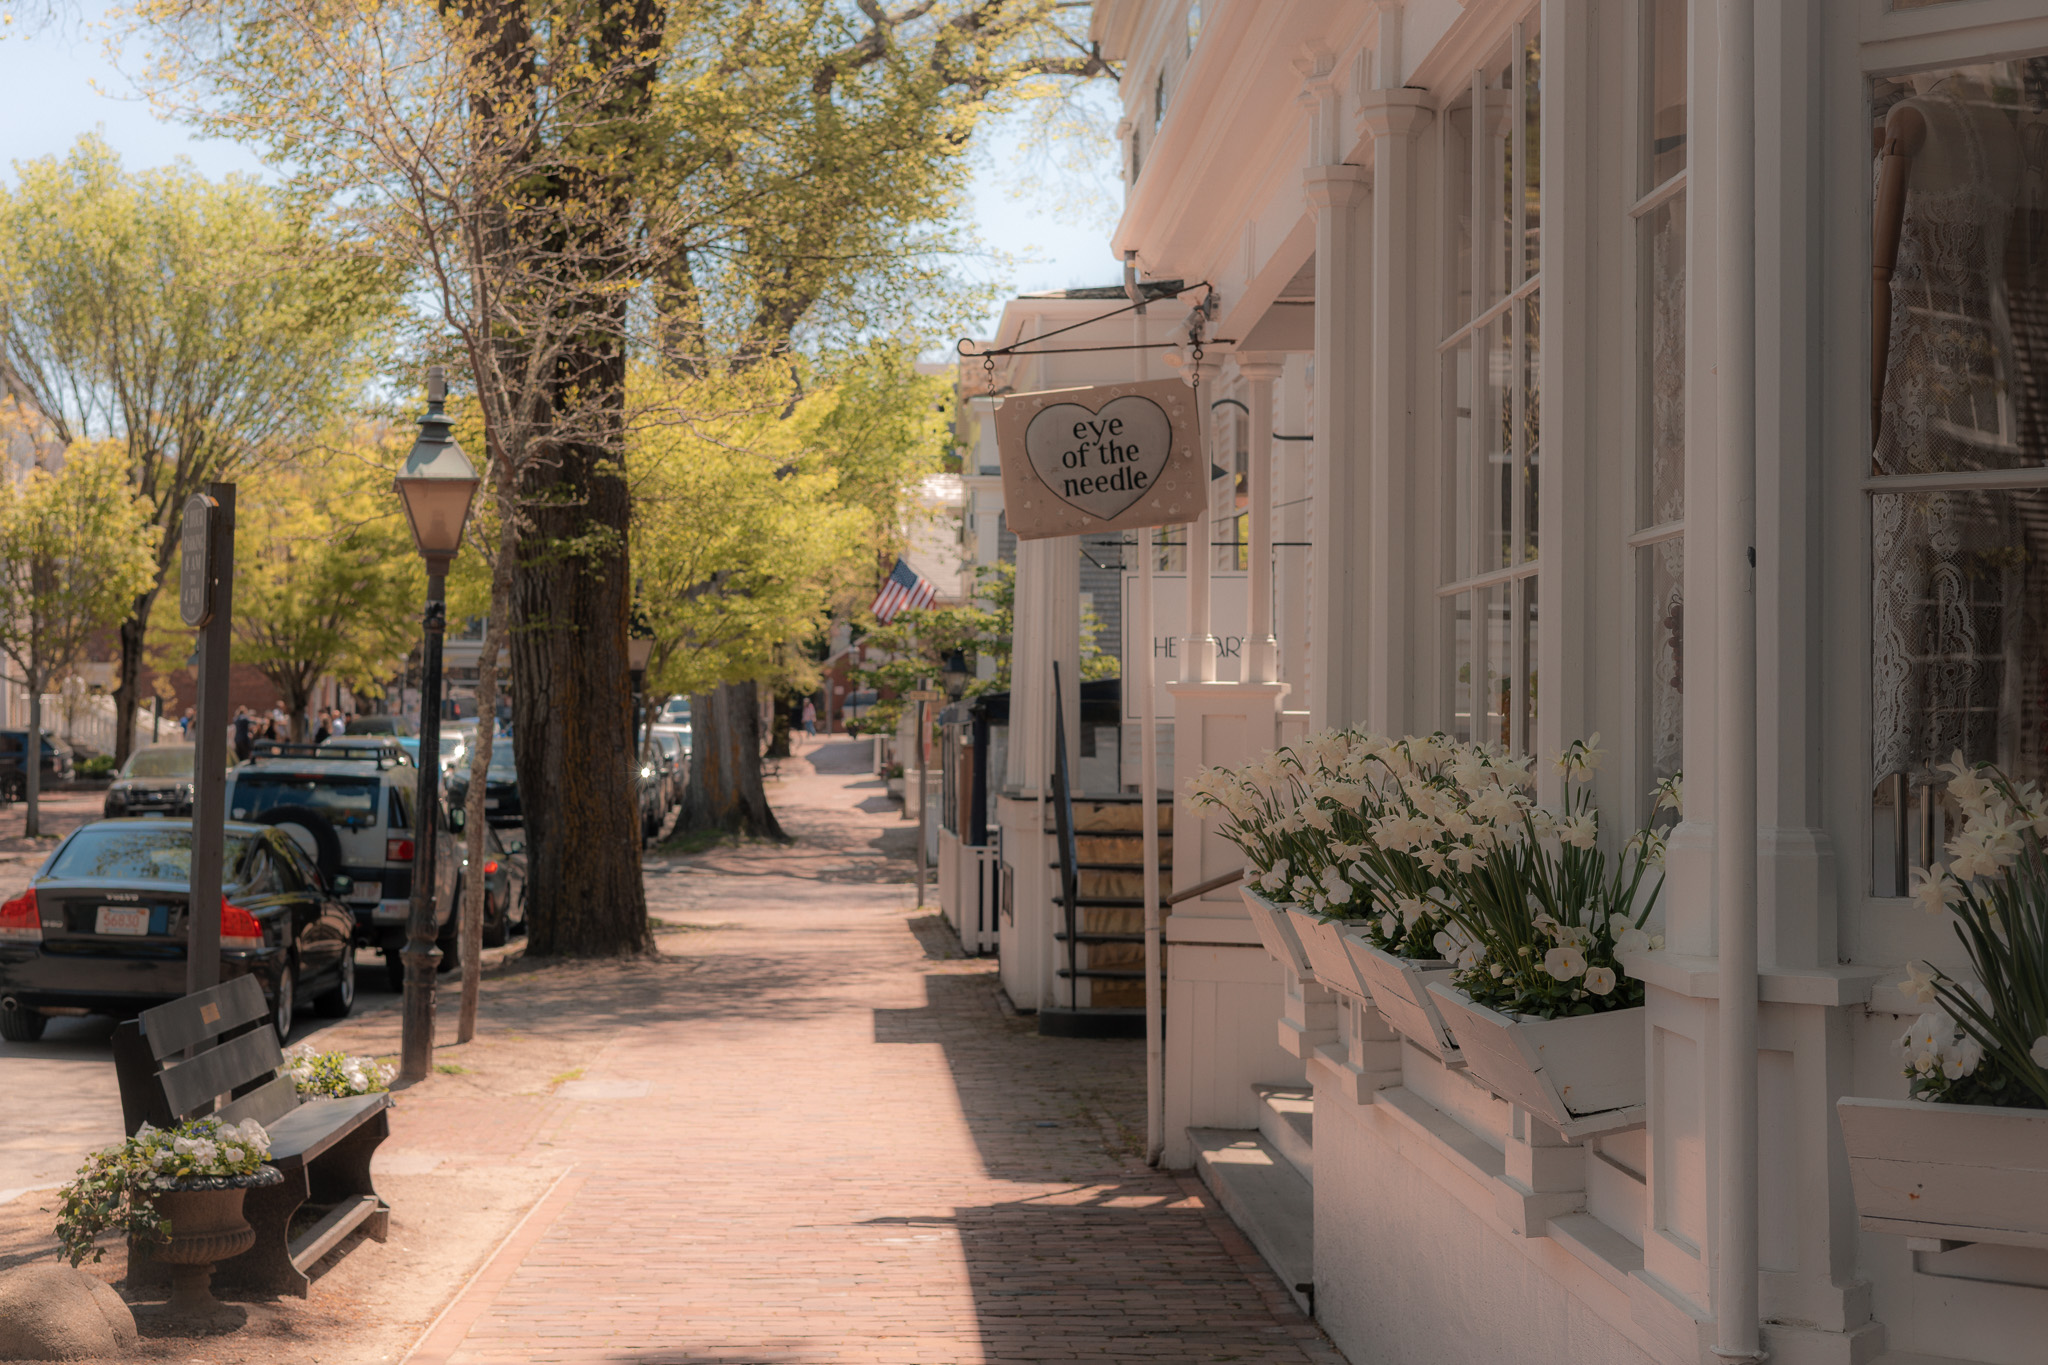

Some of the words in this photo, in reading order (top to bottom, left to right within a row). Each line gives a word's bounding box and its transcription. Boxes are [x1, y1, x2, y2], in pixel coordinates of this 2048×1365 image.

[1073, 418, 1123, 446] eye
[1062, 443, 1090, 469] of
[1099, 439, 1140, 465] the
[1064, 467, 1148, 497] needle
[184, 534, 204, 552] PARKING
[191, 553, 201, 571] AM
[190, 588, 200, 604] PM
[105, 893, 139, 901] VOLVO
